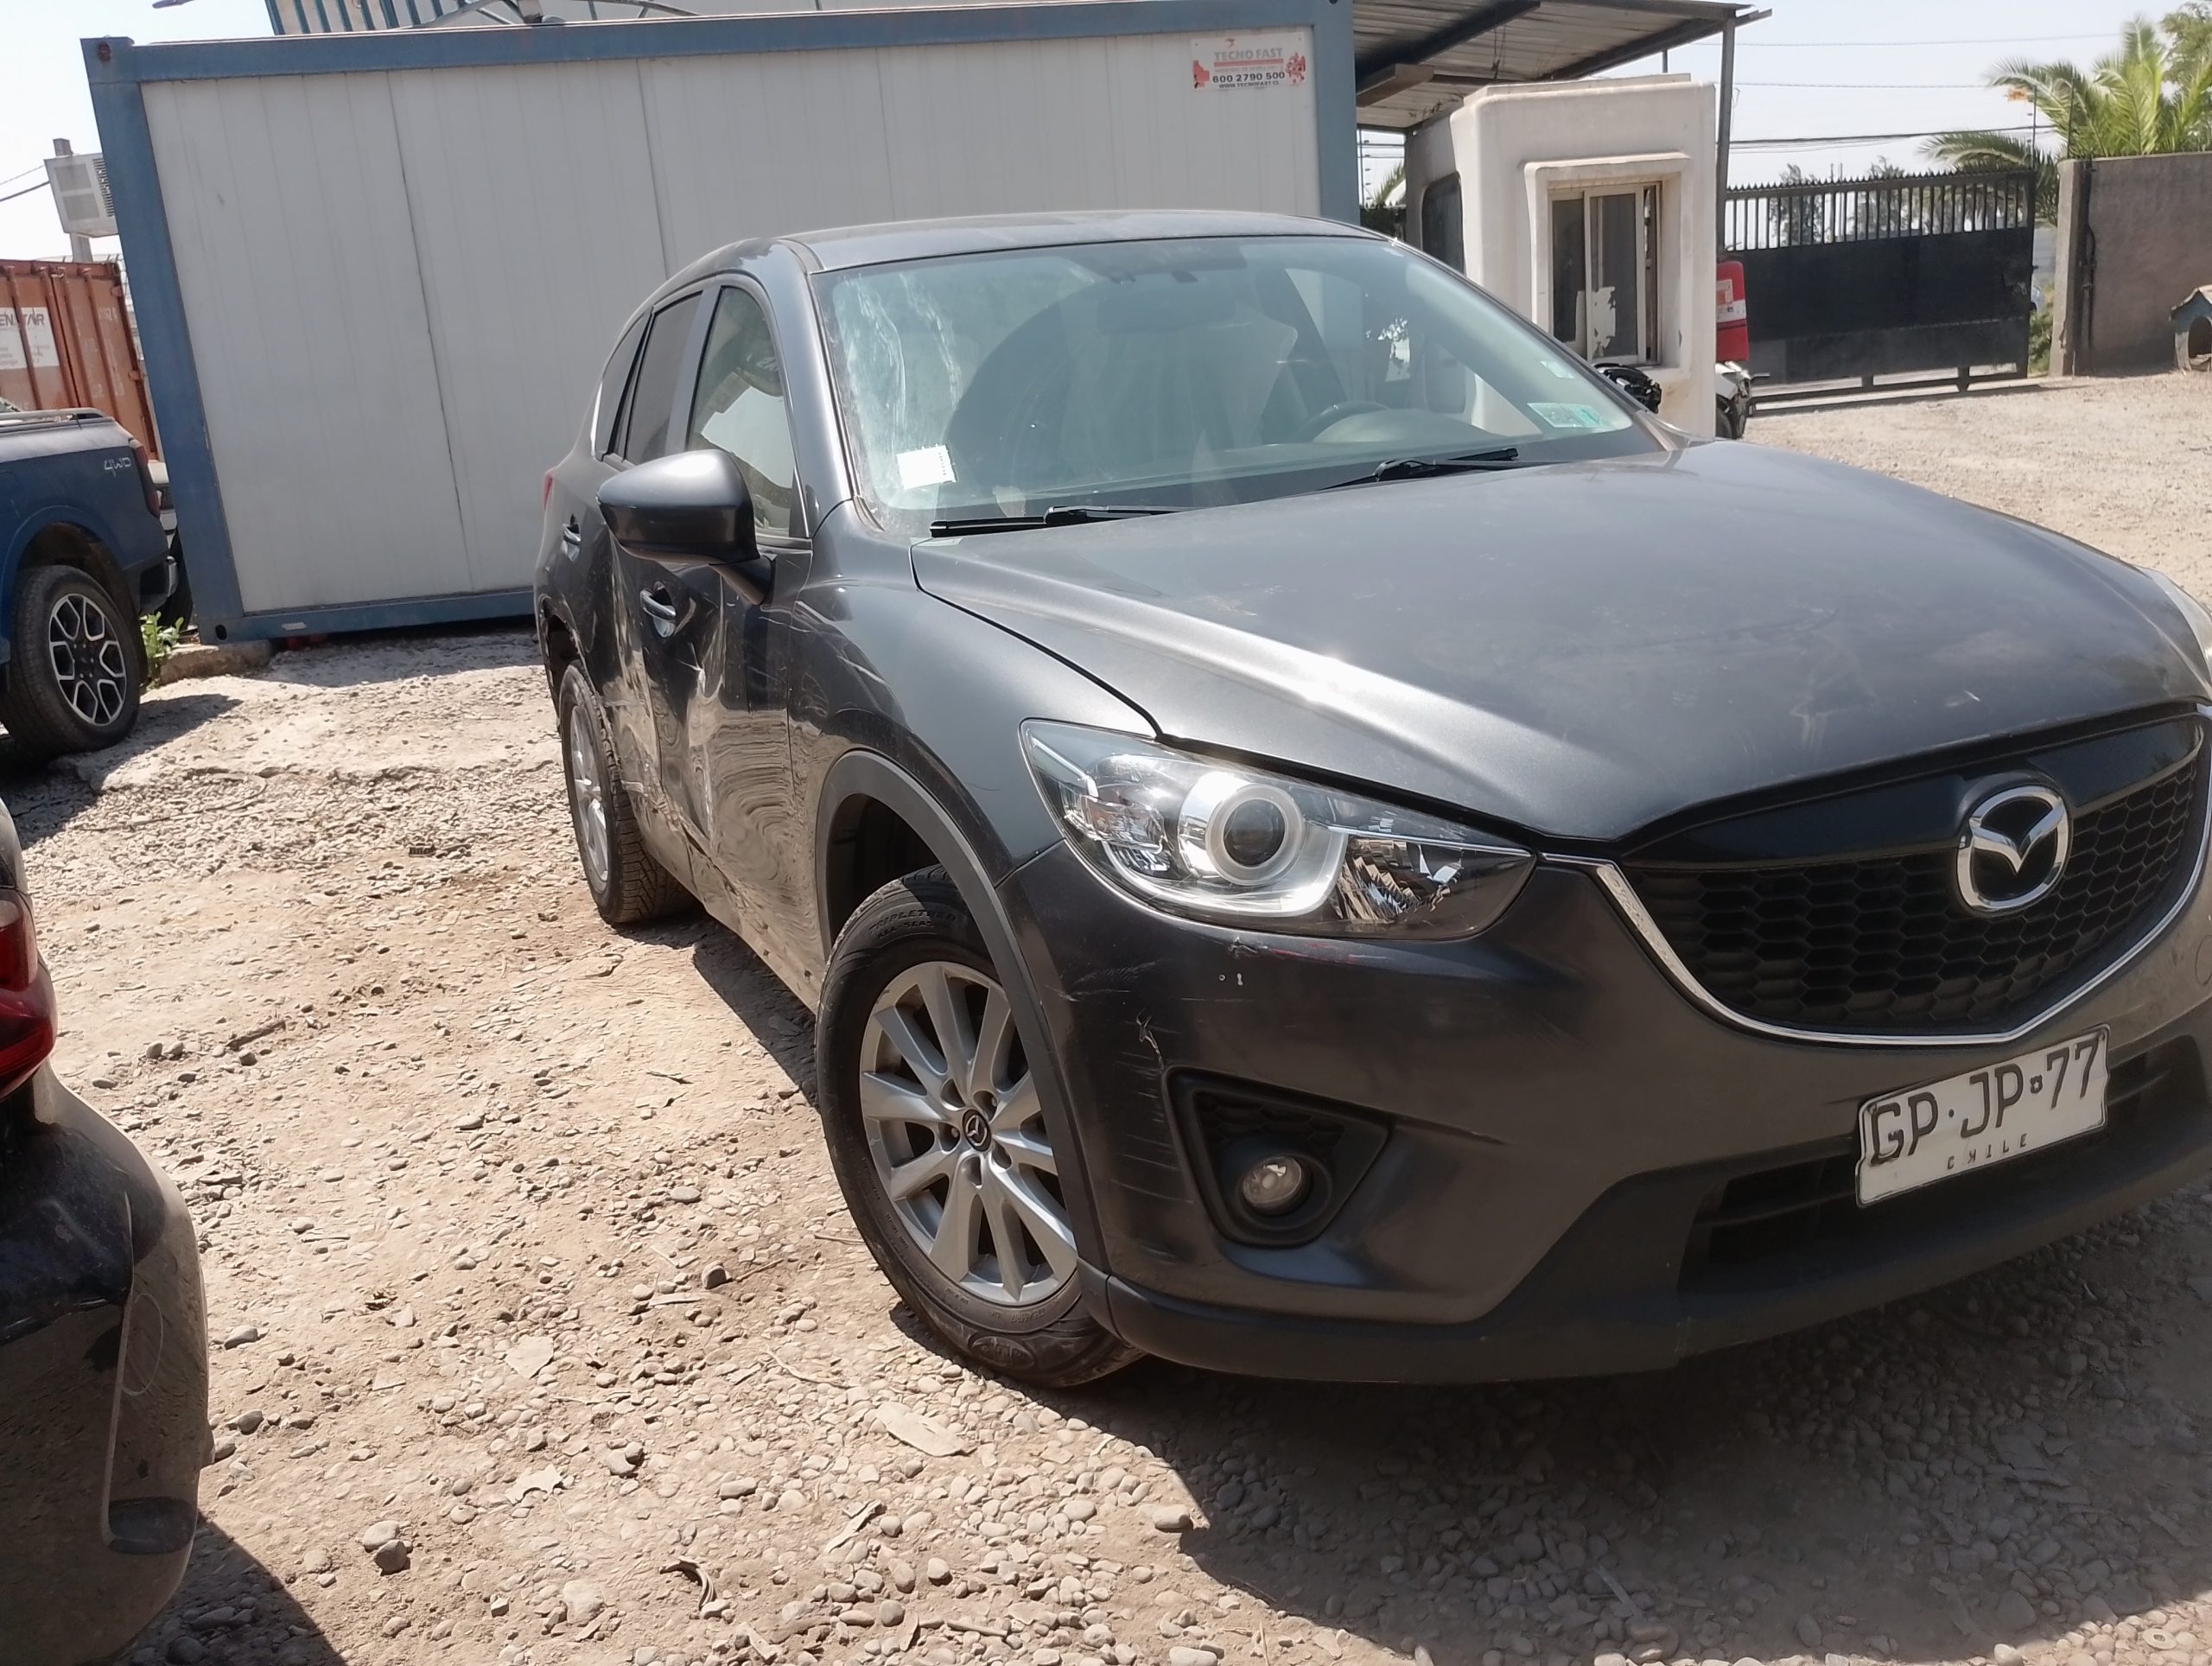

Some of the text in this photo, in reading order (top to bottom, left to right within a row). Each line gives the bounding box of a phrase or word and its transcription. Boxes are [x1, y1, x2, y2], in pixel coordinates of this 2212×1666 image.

[1213, 48, 1283, 61] TECNO FAST
[1236, 73, 1262, 82] 2790
[1265, 71, 1286, 80] 500
[104, 458, 131, 476] 4WD
[1947, 1133, 2028, 1170] CHILE
